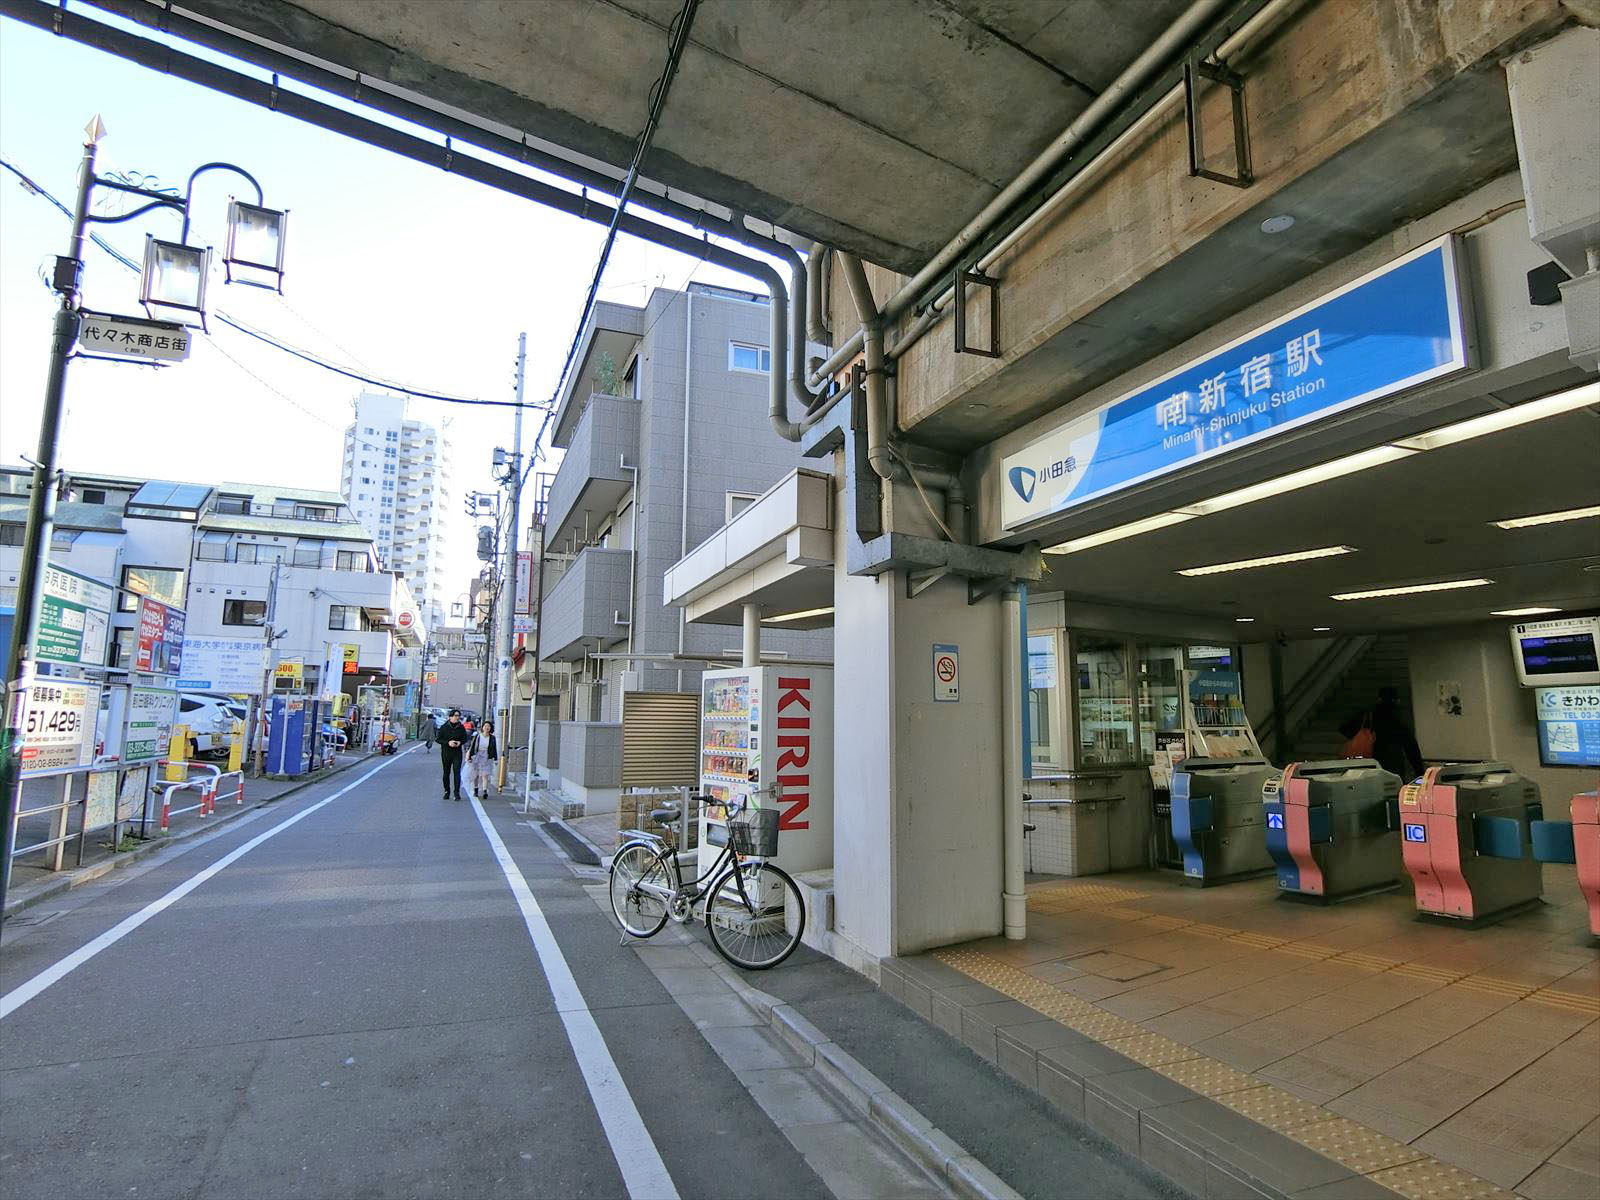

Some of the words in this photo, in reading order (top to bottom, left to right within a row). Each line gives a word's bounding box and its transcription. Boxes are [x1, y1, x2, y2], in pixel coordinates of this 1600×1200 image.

[84, 326, 187, 351] 代々木商店街
[1161, 328, 1324, 431] 南新宿駅
[1163, 400, 1267, 450] Minami-Shinjuku
[1270, 377, 1325, 408] Station
[1040, 456, 1077, 483] 小田急
[1563, 711, 1579, 720] TEL
[776, 677, 811, 831] KIRIN
[1408, 827, 1424, 840] IC
